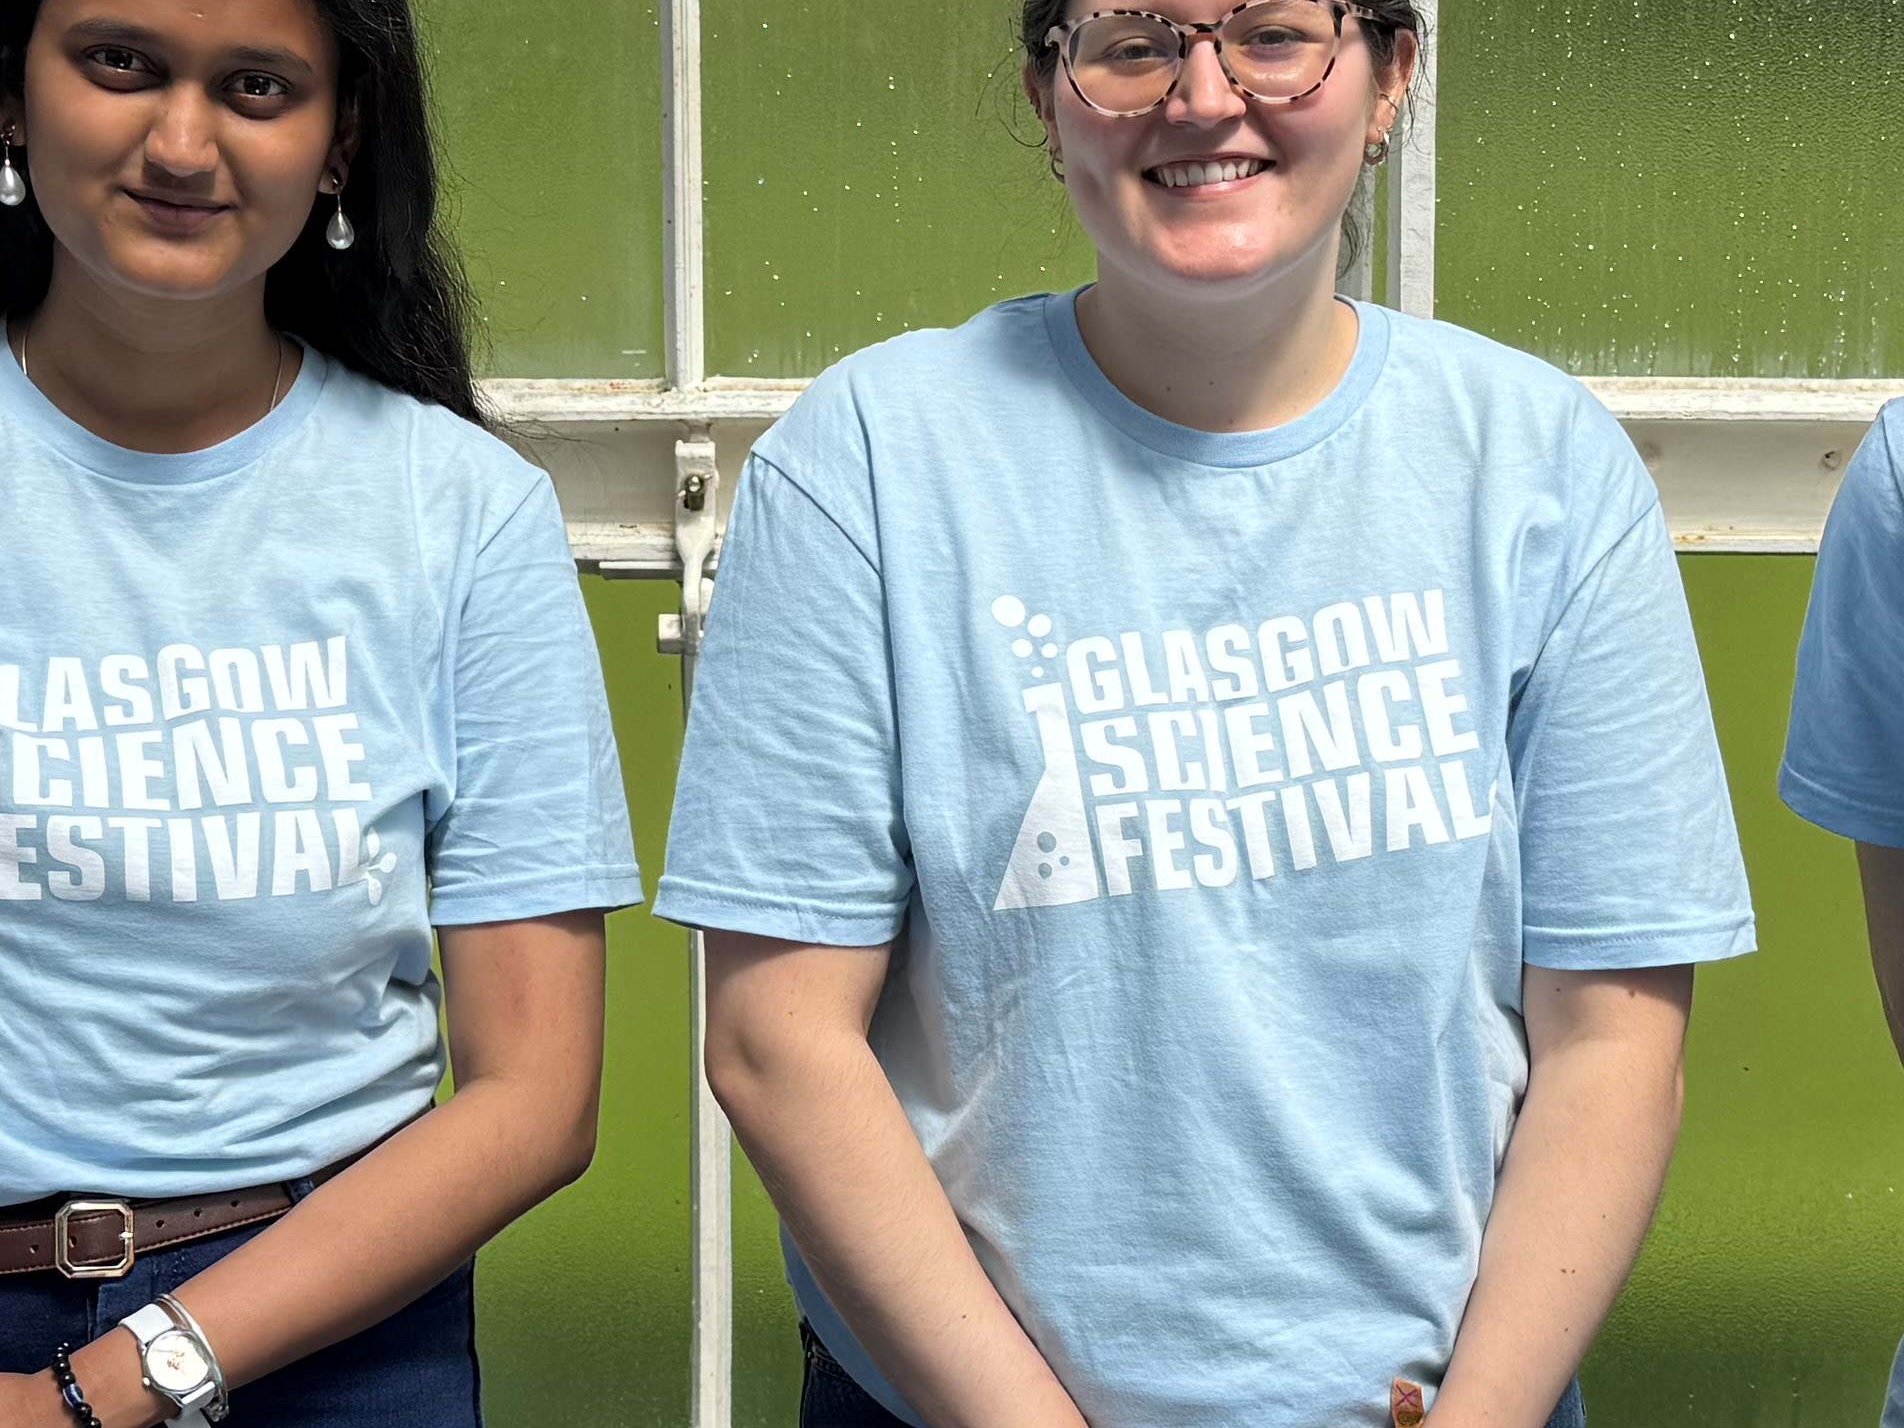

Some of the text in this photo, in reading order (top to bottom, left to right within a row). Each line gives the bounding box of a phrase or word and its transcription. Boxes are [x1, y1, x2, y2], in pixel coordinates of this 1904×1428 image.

[1065, 589, 1449, 714] GLASGOW
[1080, 659, 1479, 797] SCIENCE
[1095, 761, 1491, 898] FESTIVAL
